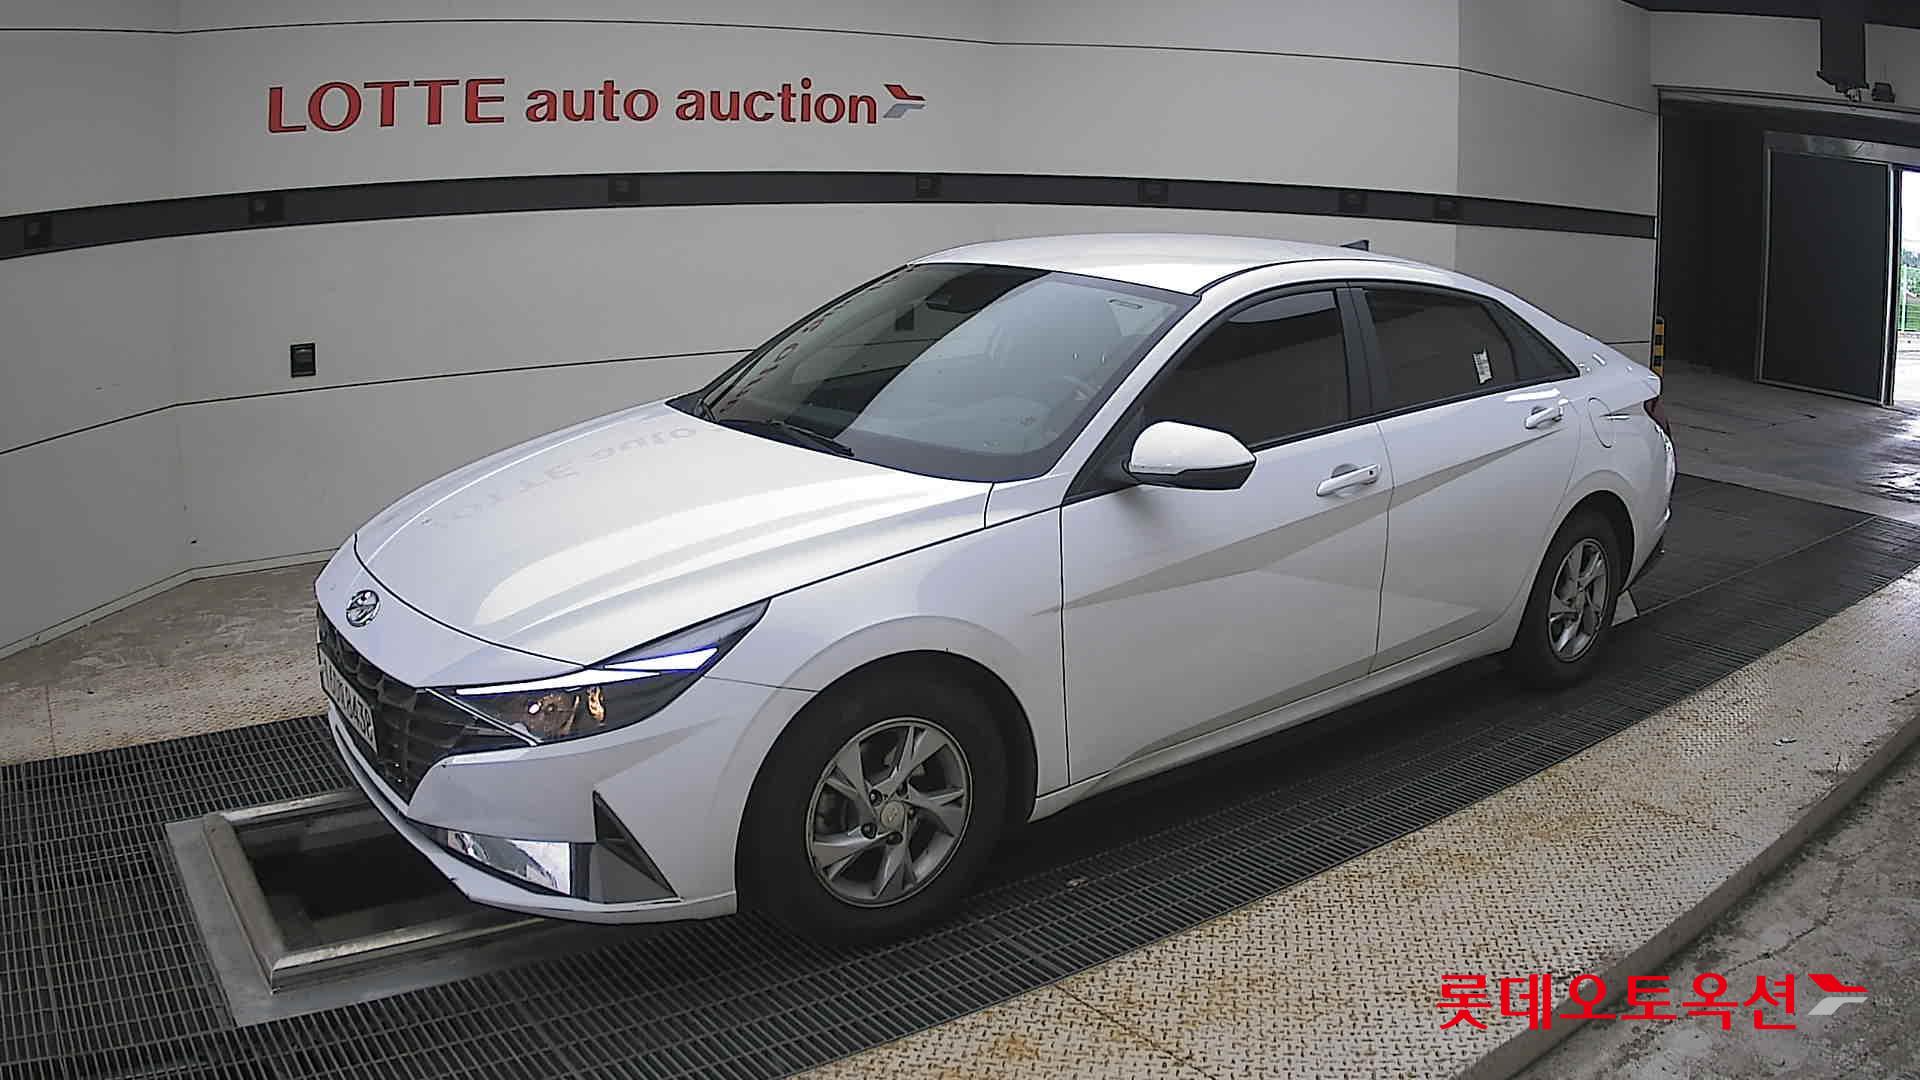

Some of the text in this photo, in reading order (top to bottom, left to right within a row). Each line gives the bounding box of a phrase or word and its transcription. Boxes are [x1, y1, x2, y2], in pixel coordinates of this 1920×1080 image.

[267, 77, 878, 134] LOTTE auto auction
